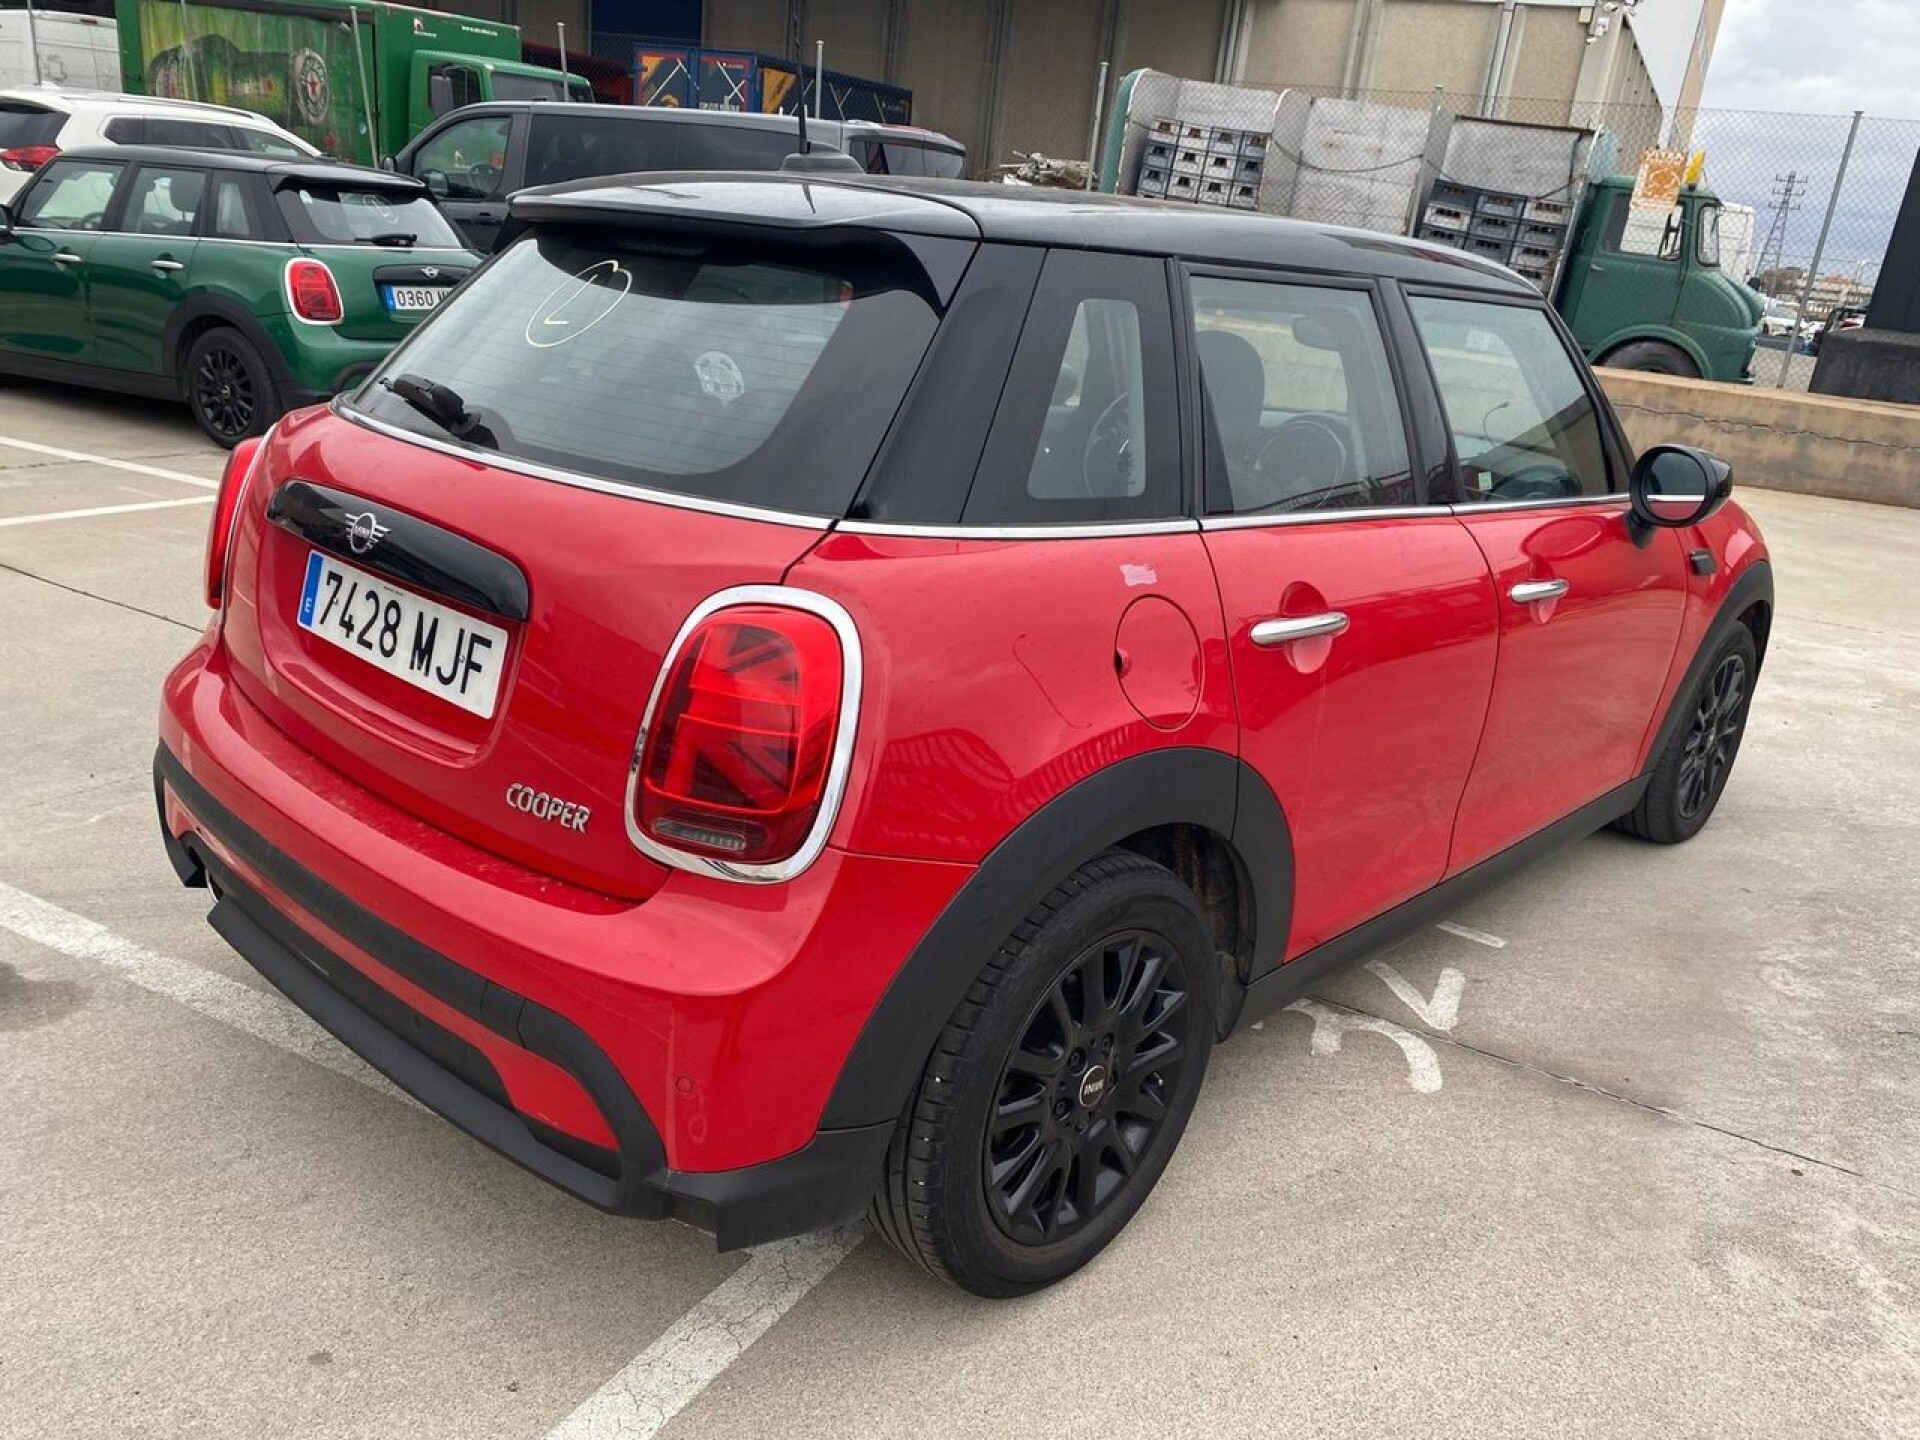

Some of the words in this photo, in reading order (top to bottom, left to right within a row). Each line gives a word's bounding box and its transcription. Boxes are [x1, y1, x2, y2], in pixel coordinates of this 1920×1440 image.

[397, 290, 434, 307] 0360
[319, 570, 401, 658] 7428
[409, 611, 493, 694] MJF
[506, 782, 591, 835] COOPER
